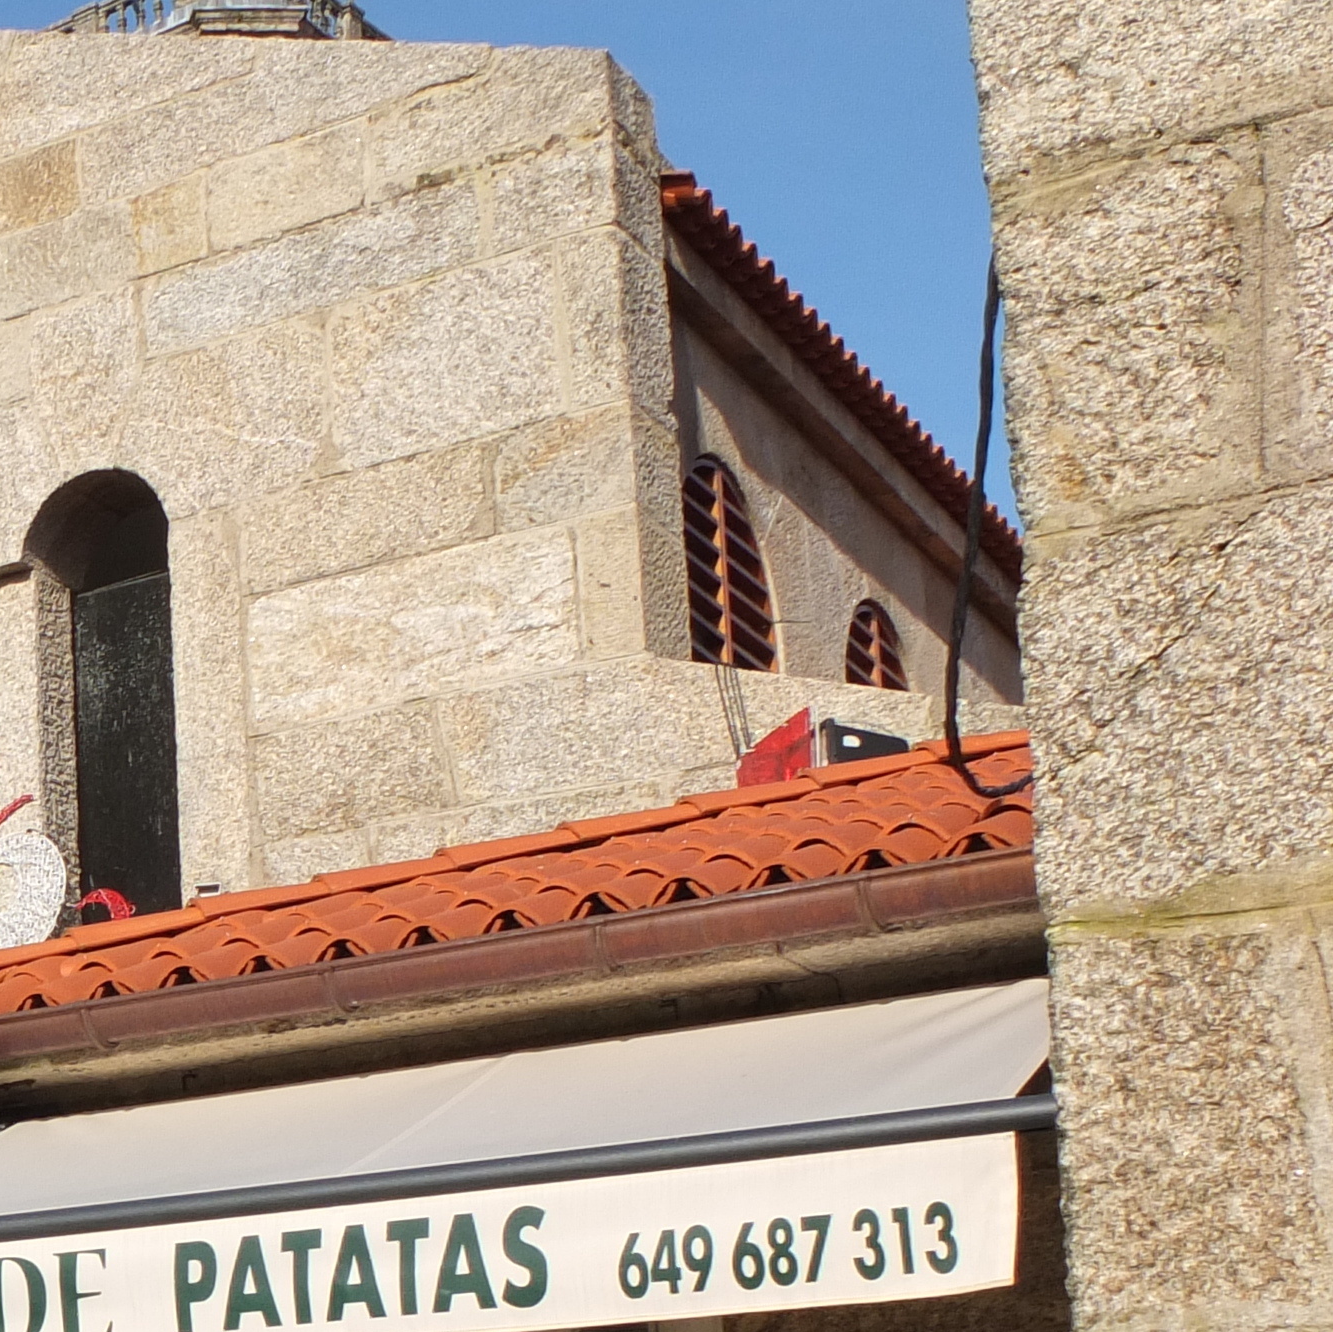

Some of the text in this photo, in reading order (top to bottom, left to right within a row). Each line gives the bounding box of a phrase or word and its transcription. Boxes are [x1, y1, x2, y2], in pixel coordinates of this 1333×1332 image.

[175, 1205, 549, 1332] PATATAS
[619, 1224, 714, 1298] 649
[732, 1214, 830, 1290] 687
[852, 1201, 959, 1280] 313
